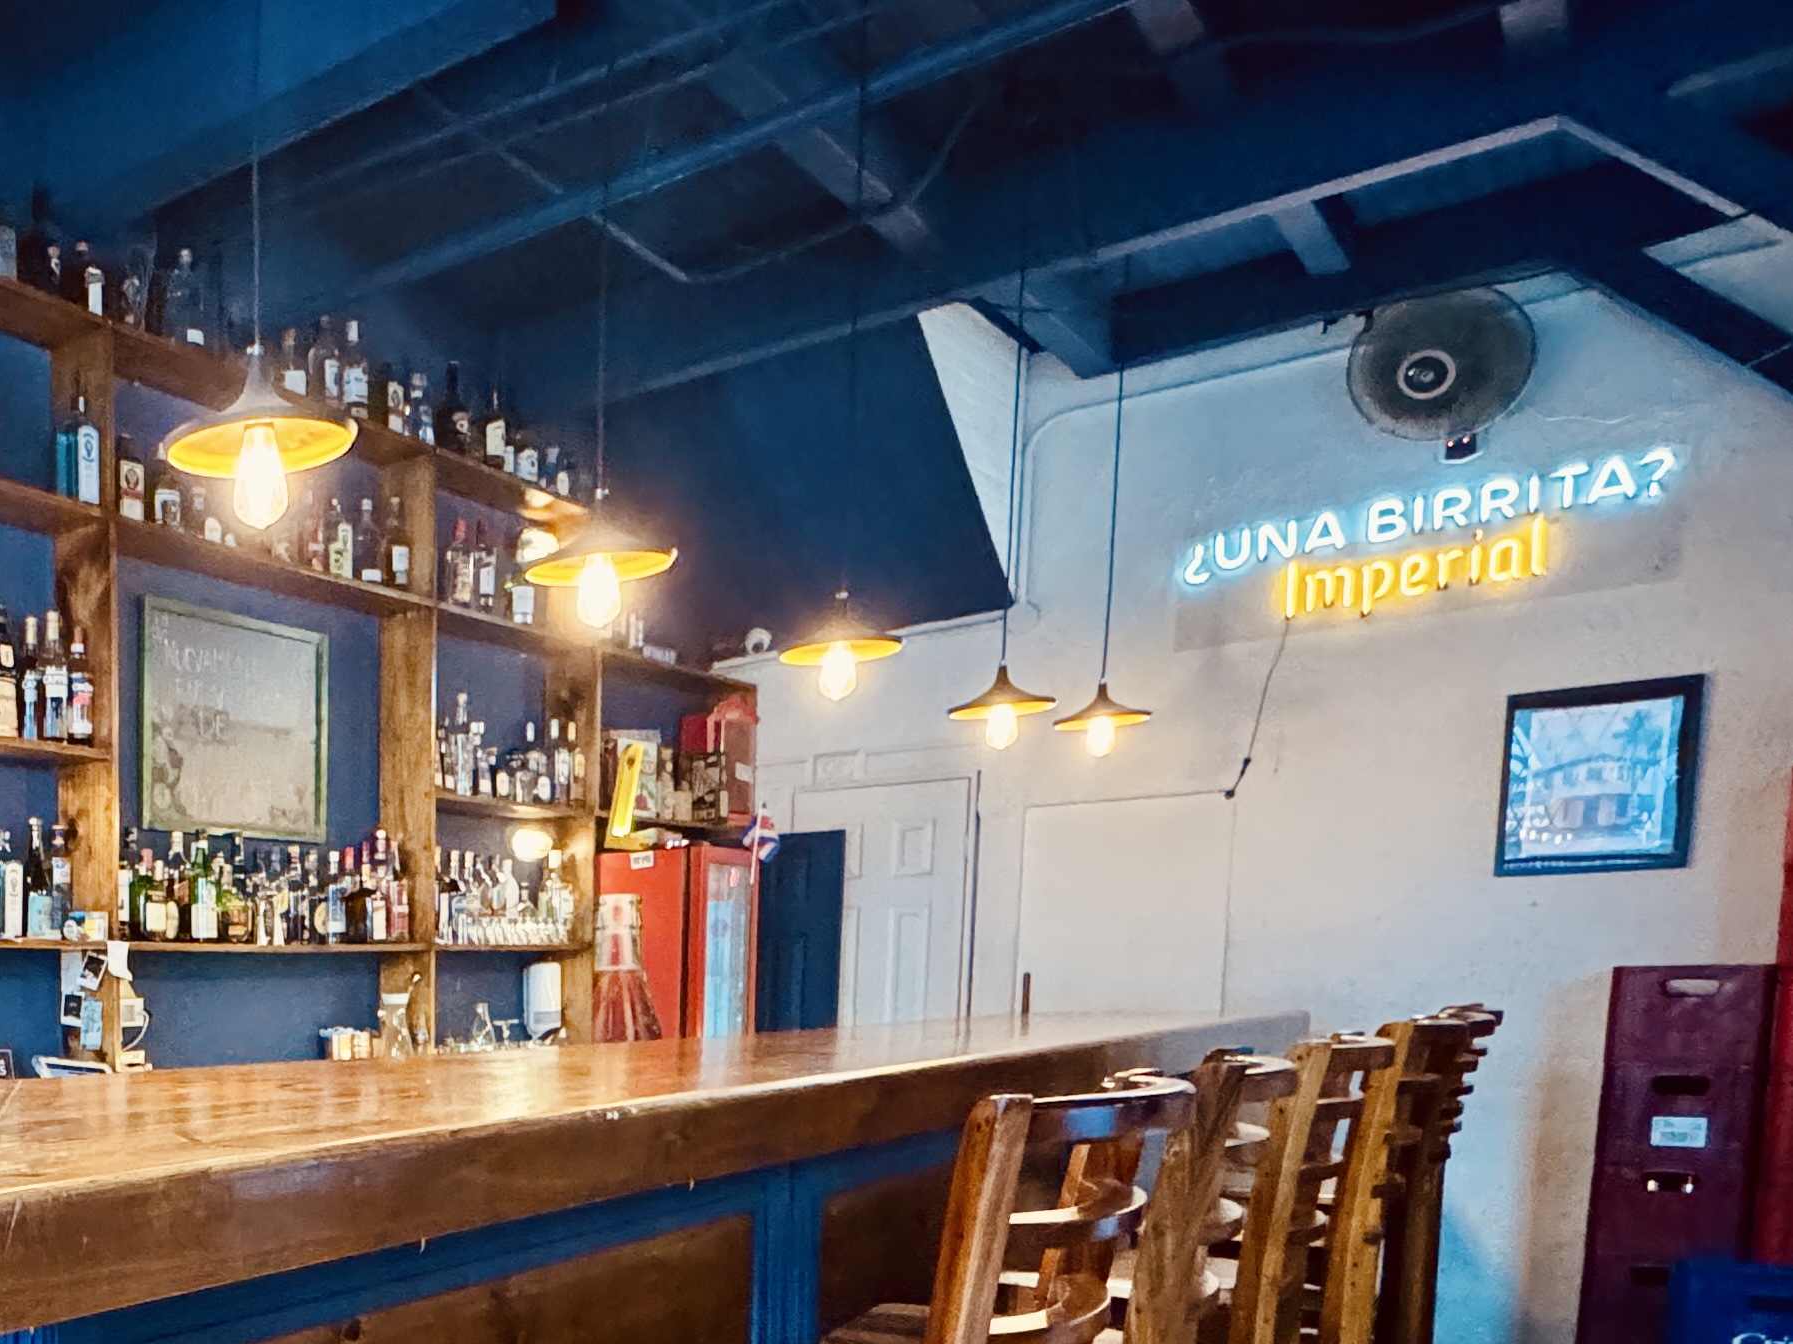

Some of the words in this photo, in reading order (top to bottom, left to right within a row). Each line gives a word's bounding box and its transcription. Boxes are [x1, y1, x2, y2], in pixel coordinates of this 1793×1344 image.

[1182, 510, 1346, 586] ¿UNA
[1365, 448, 1677, 545] BIRRITA?
[1284, 512, 1549, 619] Imperial
